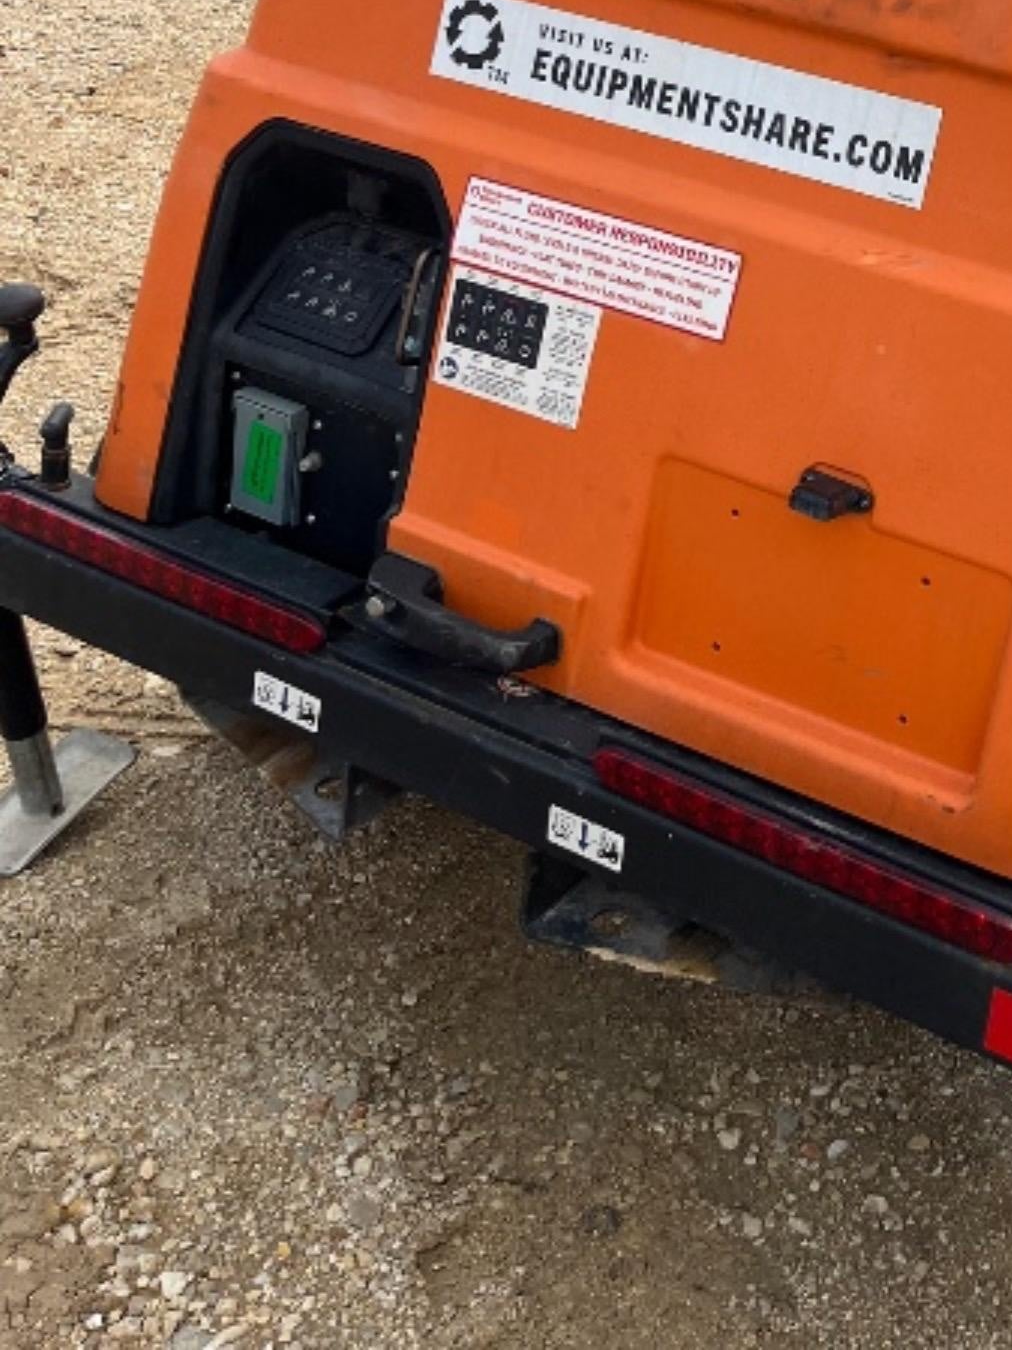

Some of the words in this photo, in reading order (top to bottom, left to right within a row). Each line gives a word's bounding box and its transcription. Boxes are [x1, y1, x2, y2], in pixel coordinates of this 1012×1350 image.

[538, 22, 586, 49] VISIT
[592, 36, 614, 56] US
[619, 45, 650, 65] AT:
[529, 48, 924, 184] EQUIPMENTSHARE.COM
